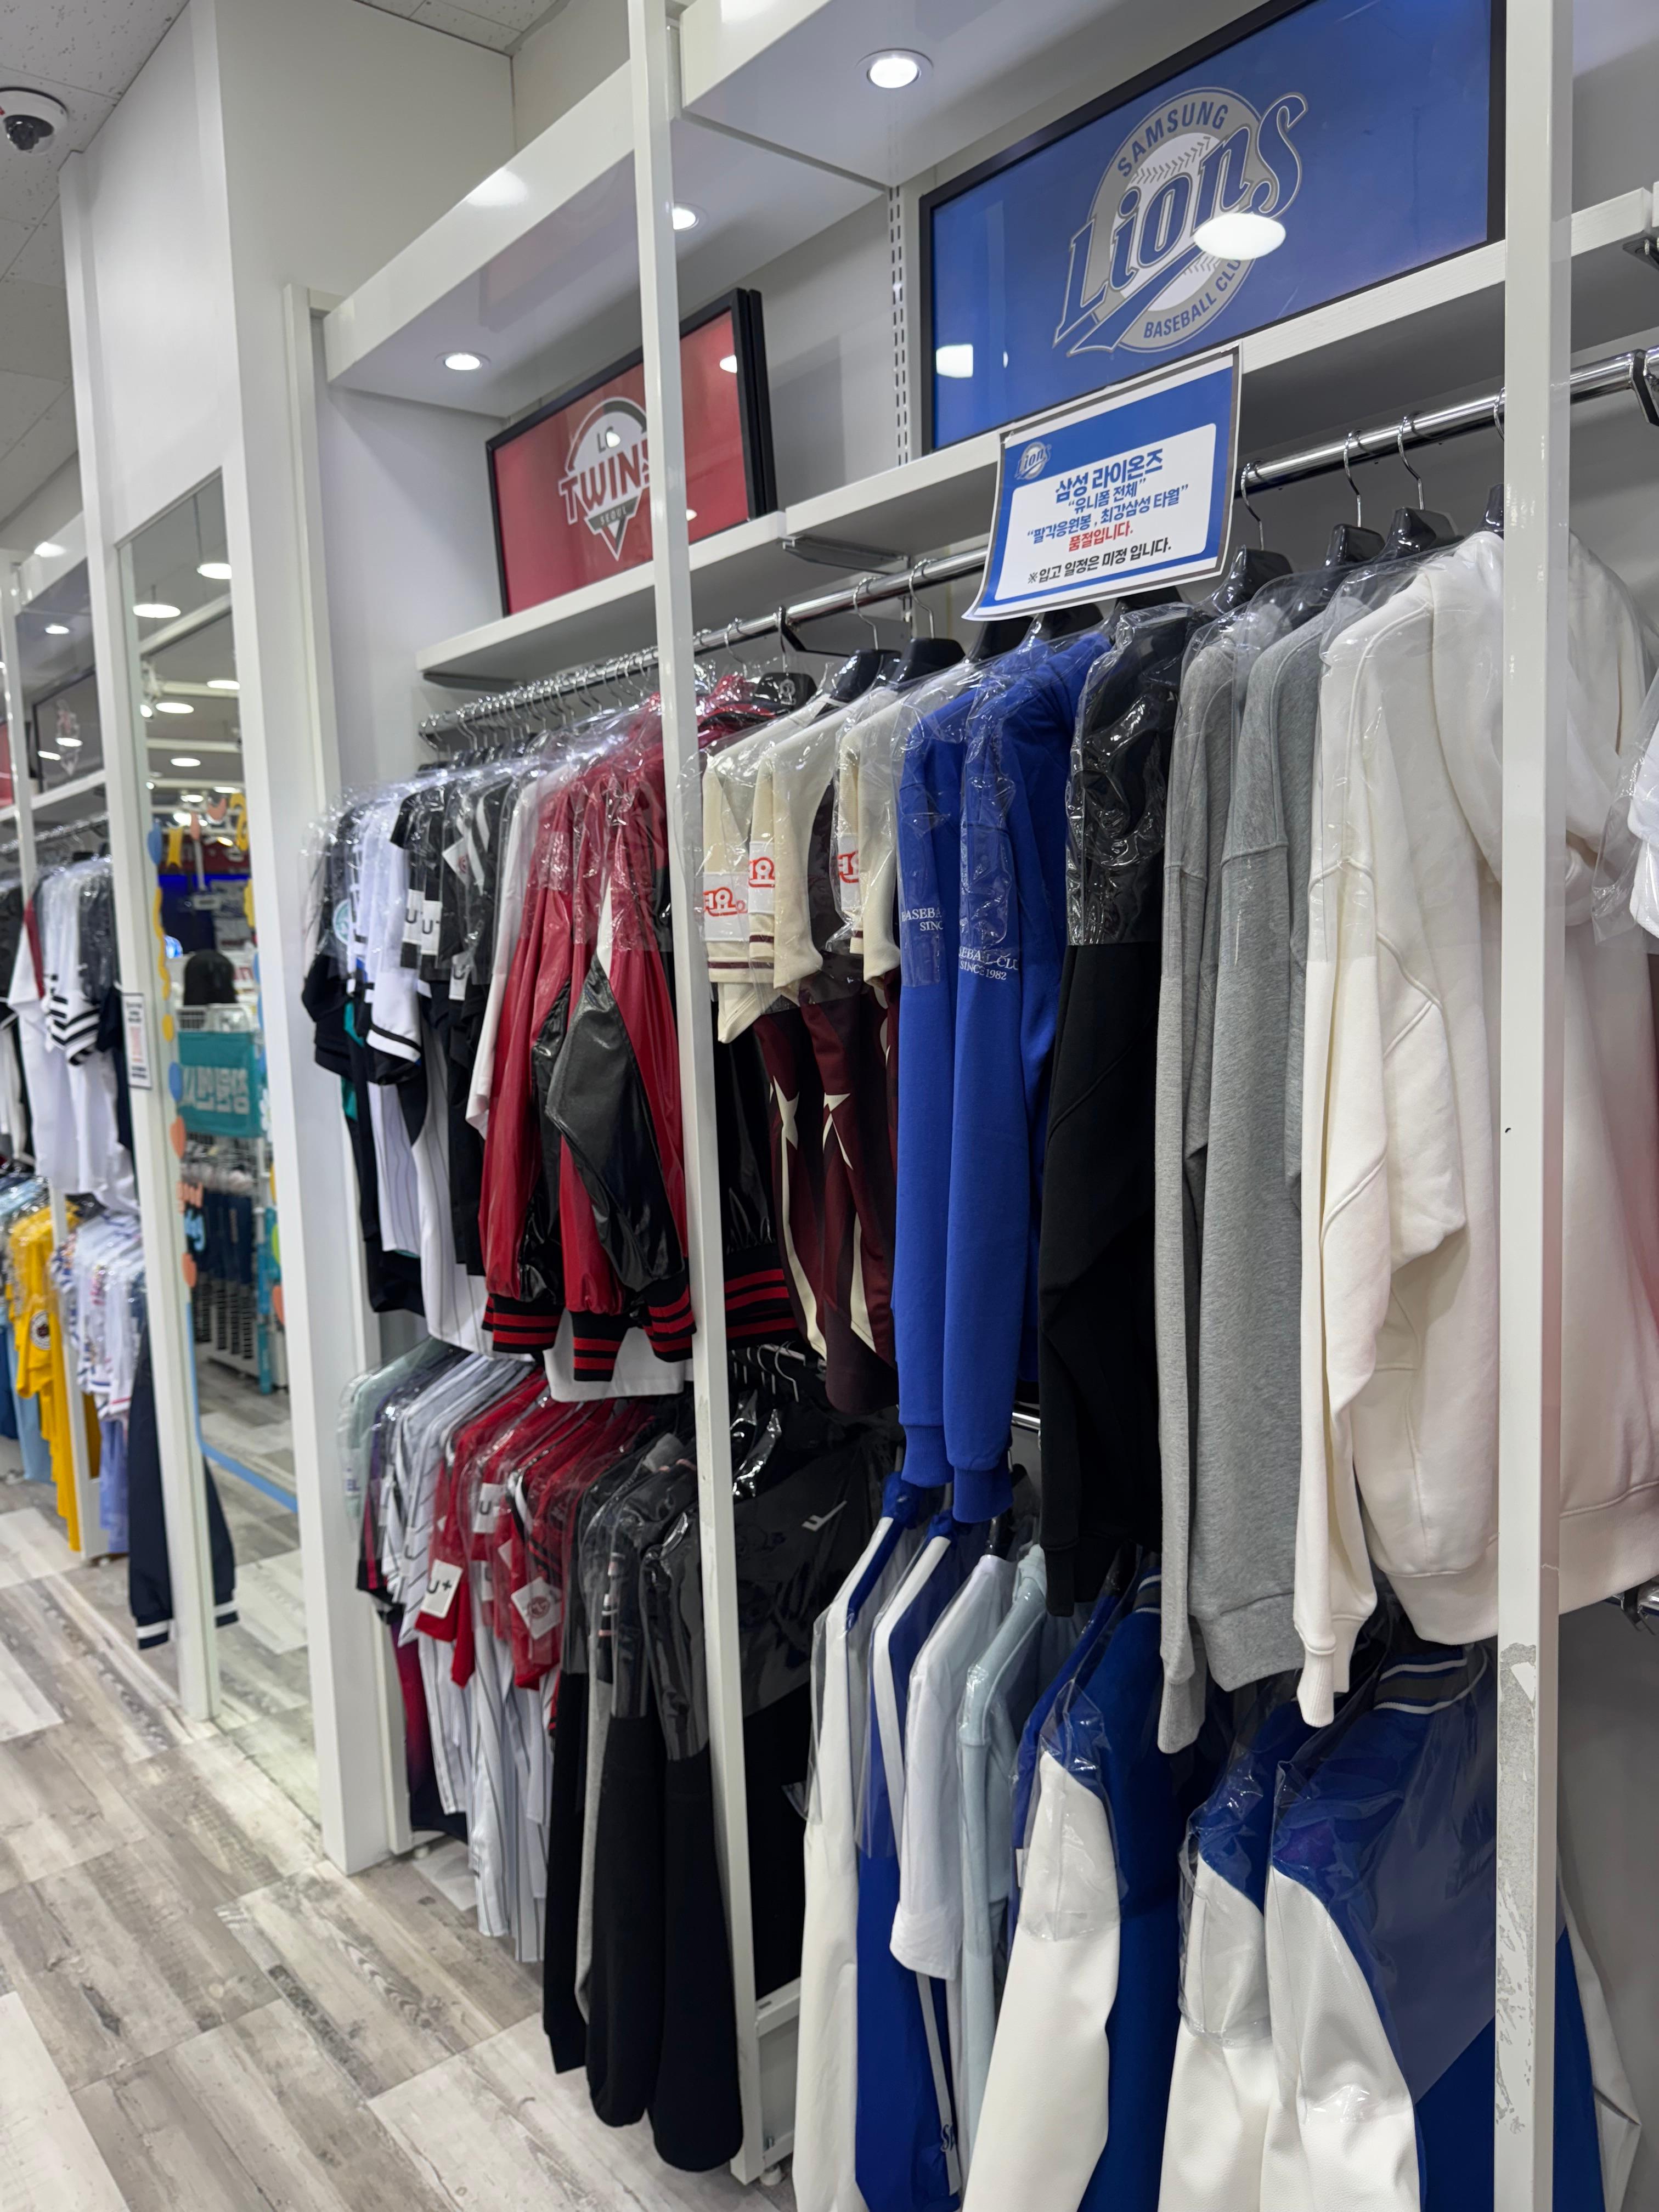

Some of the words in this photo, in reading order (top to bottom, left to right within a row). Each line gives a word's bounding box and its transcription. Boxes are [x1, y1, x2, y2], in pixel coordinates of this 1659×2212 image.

[1117, 100, 1229, 177] SAMSUNG
[1143, 292, 1217, 338] BASEBALL
[1215, 259, 1242, 292] CLU
[1056, 472, 1089, 504] 삼성
[1092, 448, 1163, 489] 라이온즈
[1101, 495, 1151, 524] 최강삼성
[1068, 521, 1133, 552] 품절입니다.
[1064, 555, 1099, 577] 일정은
[1102, 548, 1128, 566] 미정
[1130, 537, 1172, 562] 입니다.
[960, 960, 986, 976] SINCE
[986, 968, 1007, 981] 1982
[426, 1579, 452, 1594] U+
